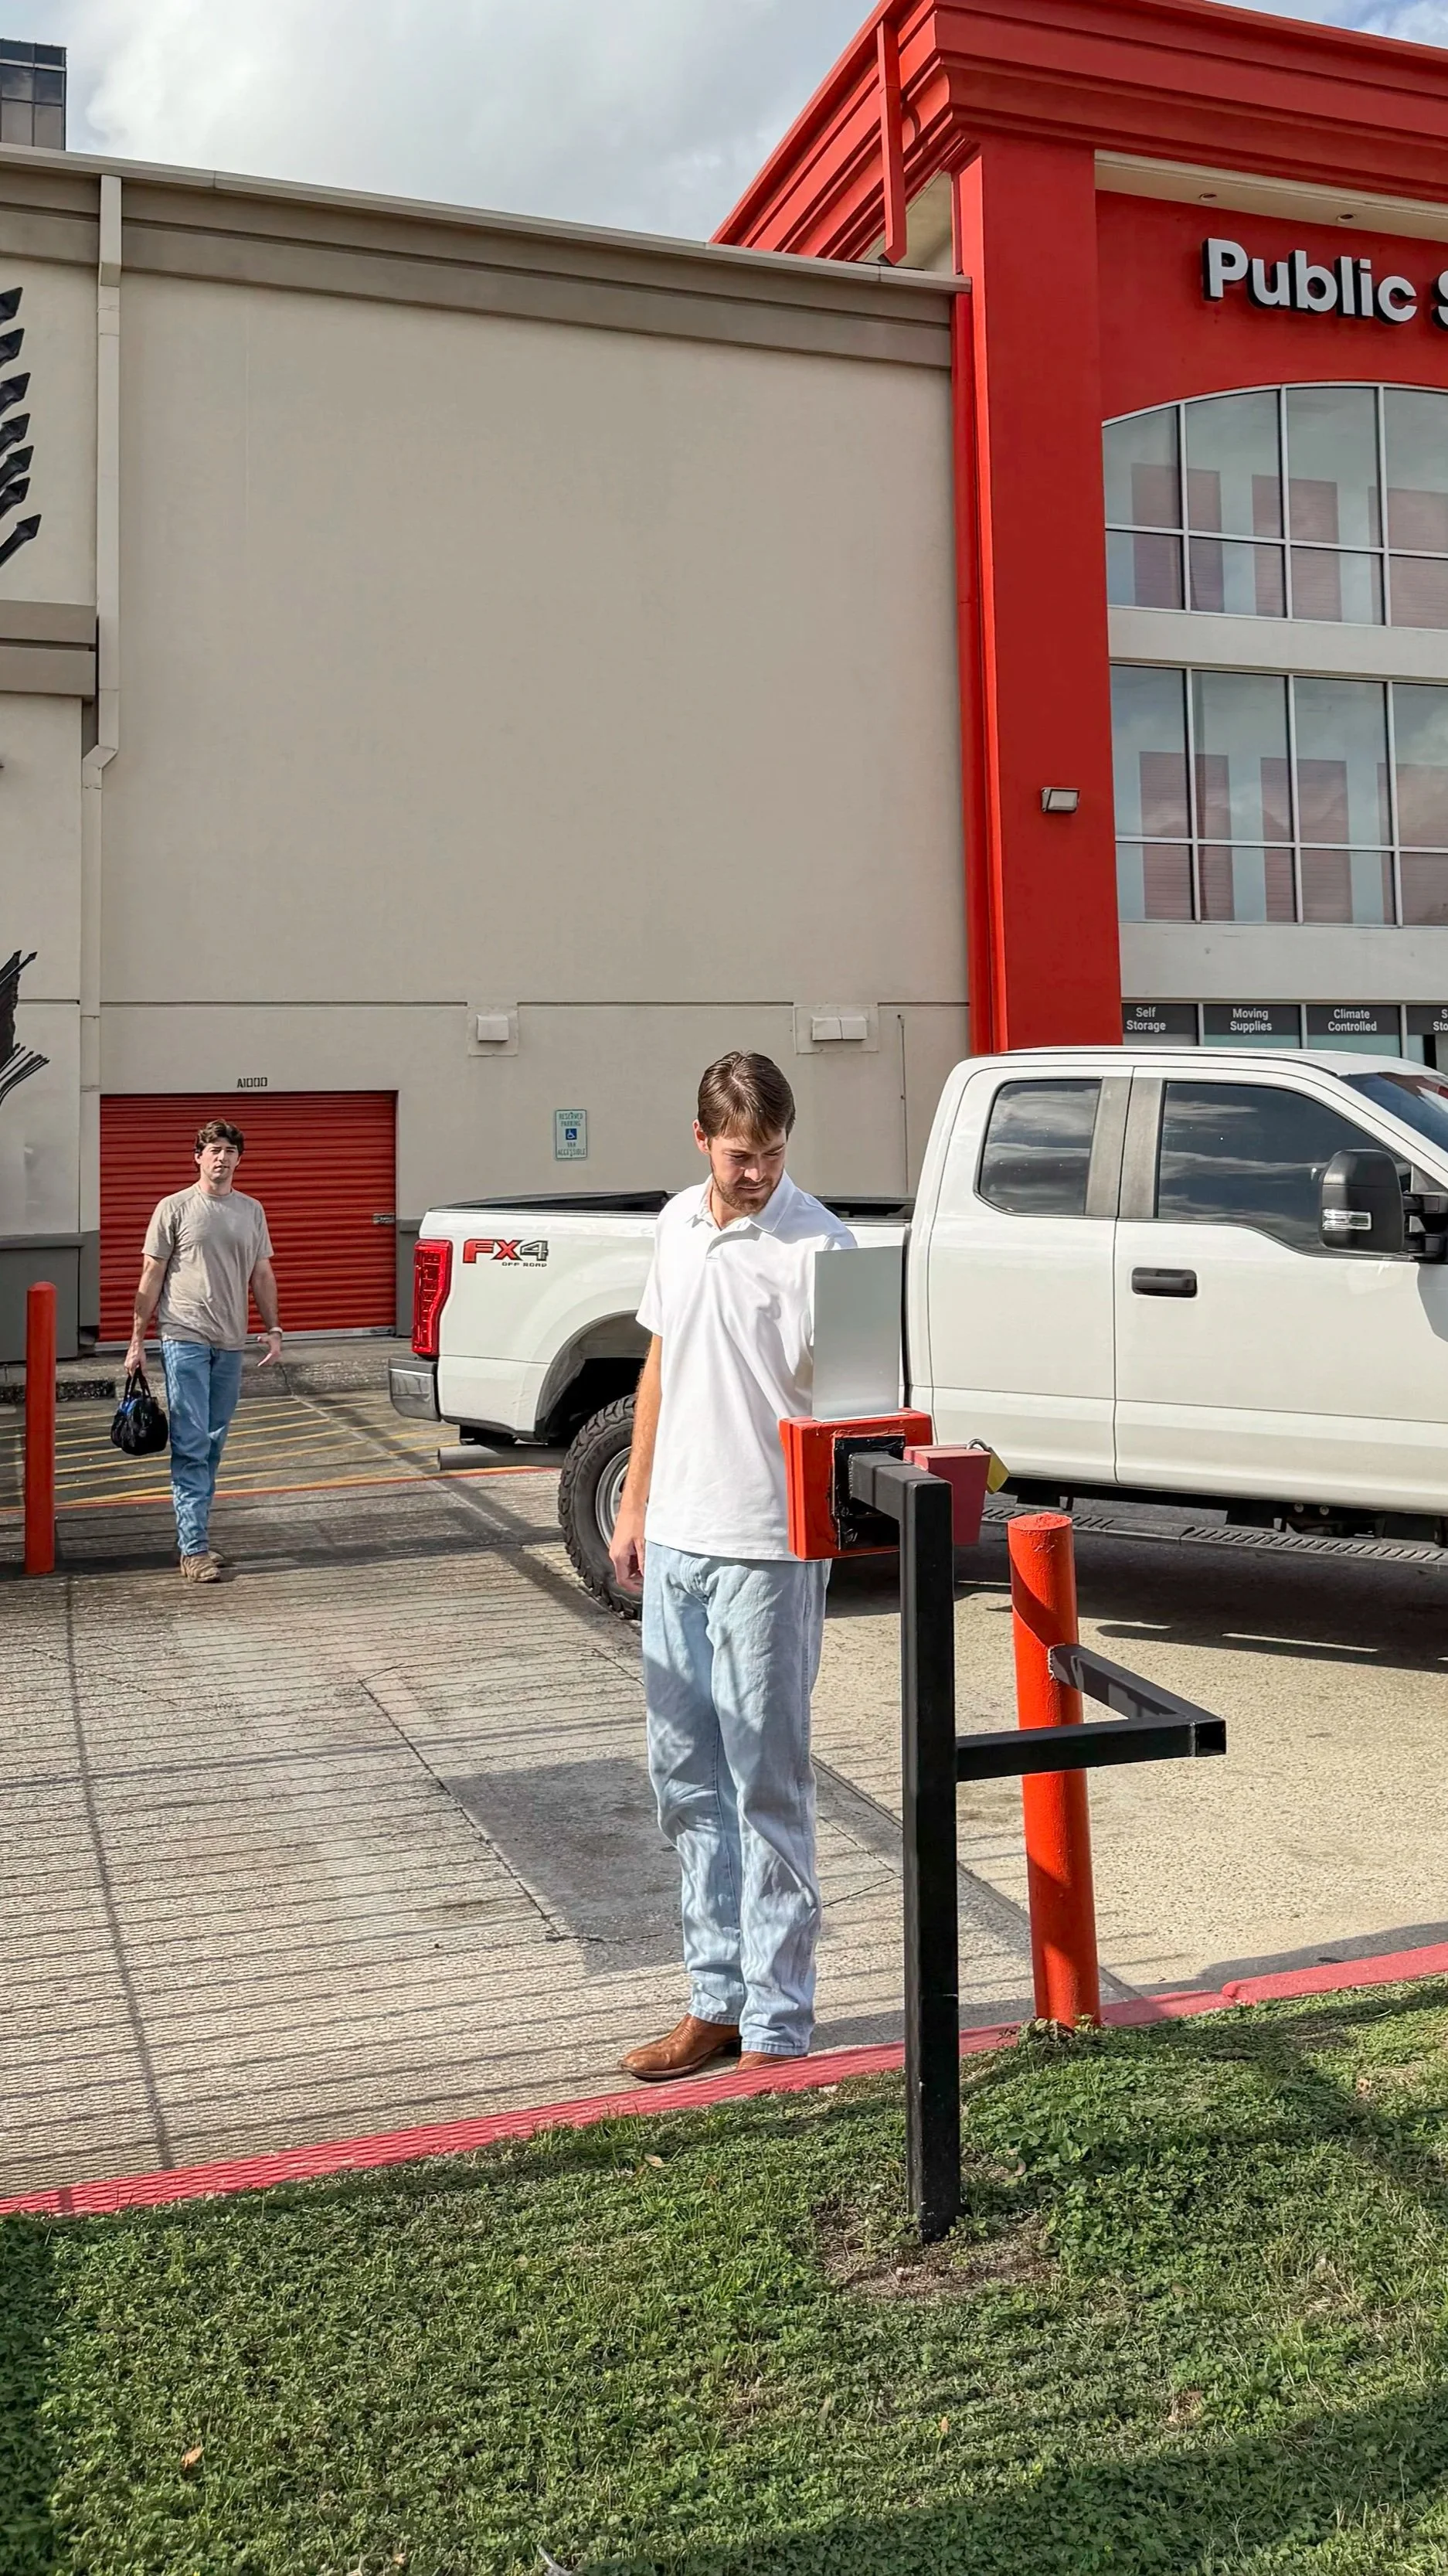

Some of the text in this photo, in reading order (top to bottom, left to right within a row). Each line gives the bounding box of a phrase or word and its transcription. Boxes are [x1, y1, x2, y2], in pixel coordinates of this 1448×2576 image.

[1205, 237, 1418, 323] Public
[1135, 1007, 1157, 1018] Self
[1232, 1008, 1269, 1021] Moving
[1333, 1008, 1370, 1019] Climate
[1126, 1020, 1167, 1033] Storage
[1229, 1020, 1273, 1033] Supplies
[1327, 1021, 1378, 1032] Controlled
[1433, 1021, 1448, 1031] Sto
[462, 1239, 549, 1264] FX4
